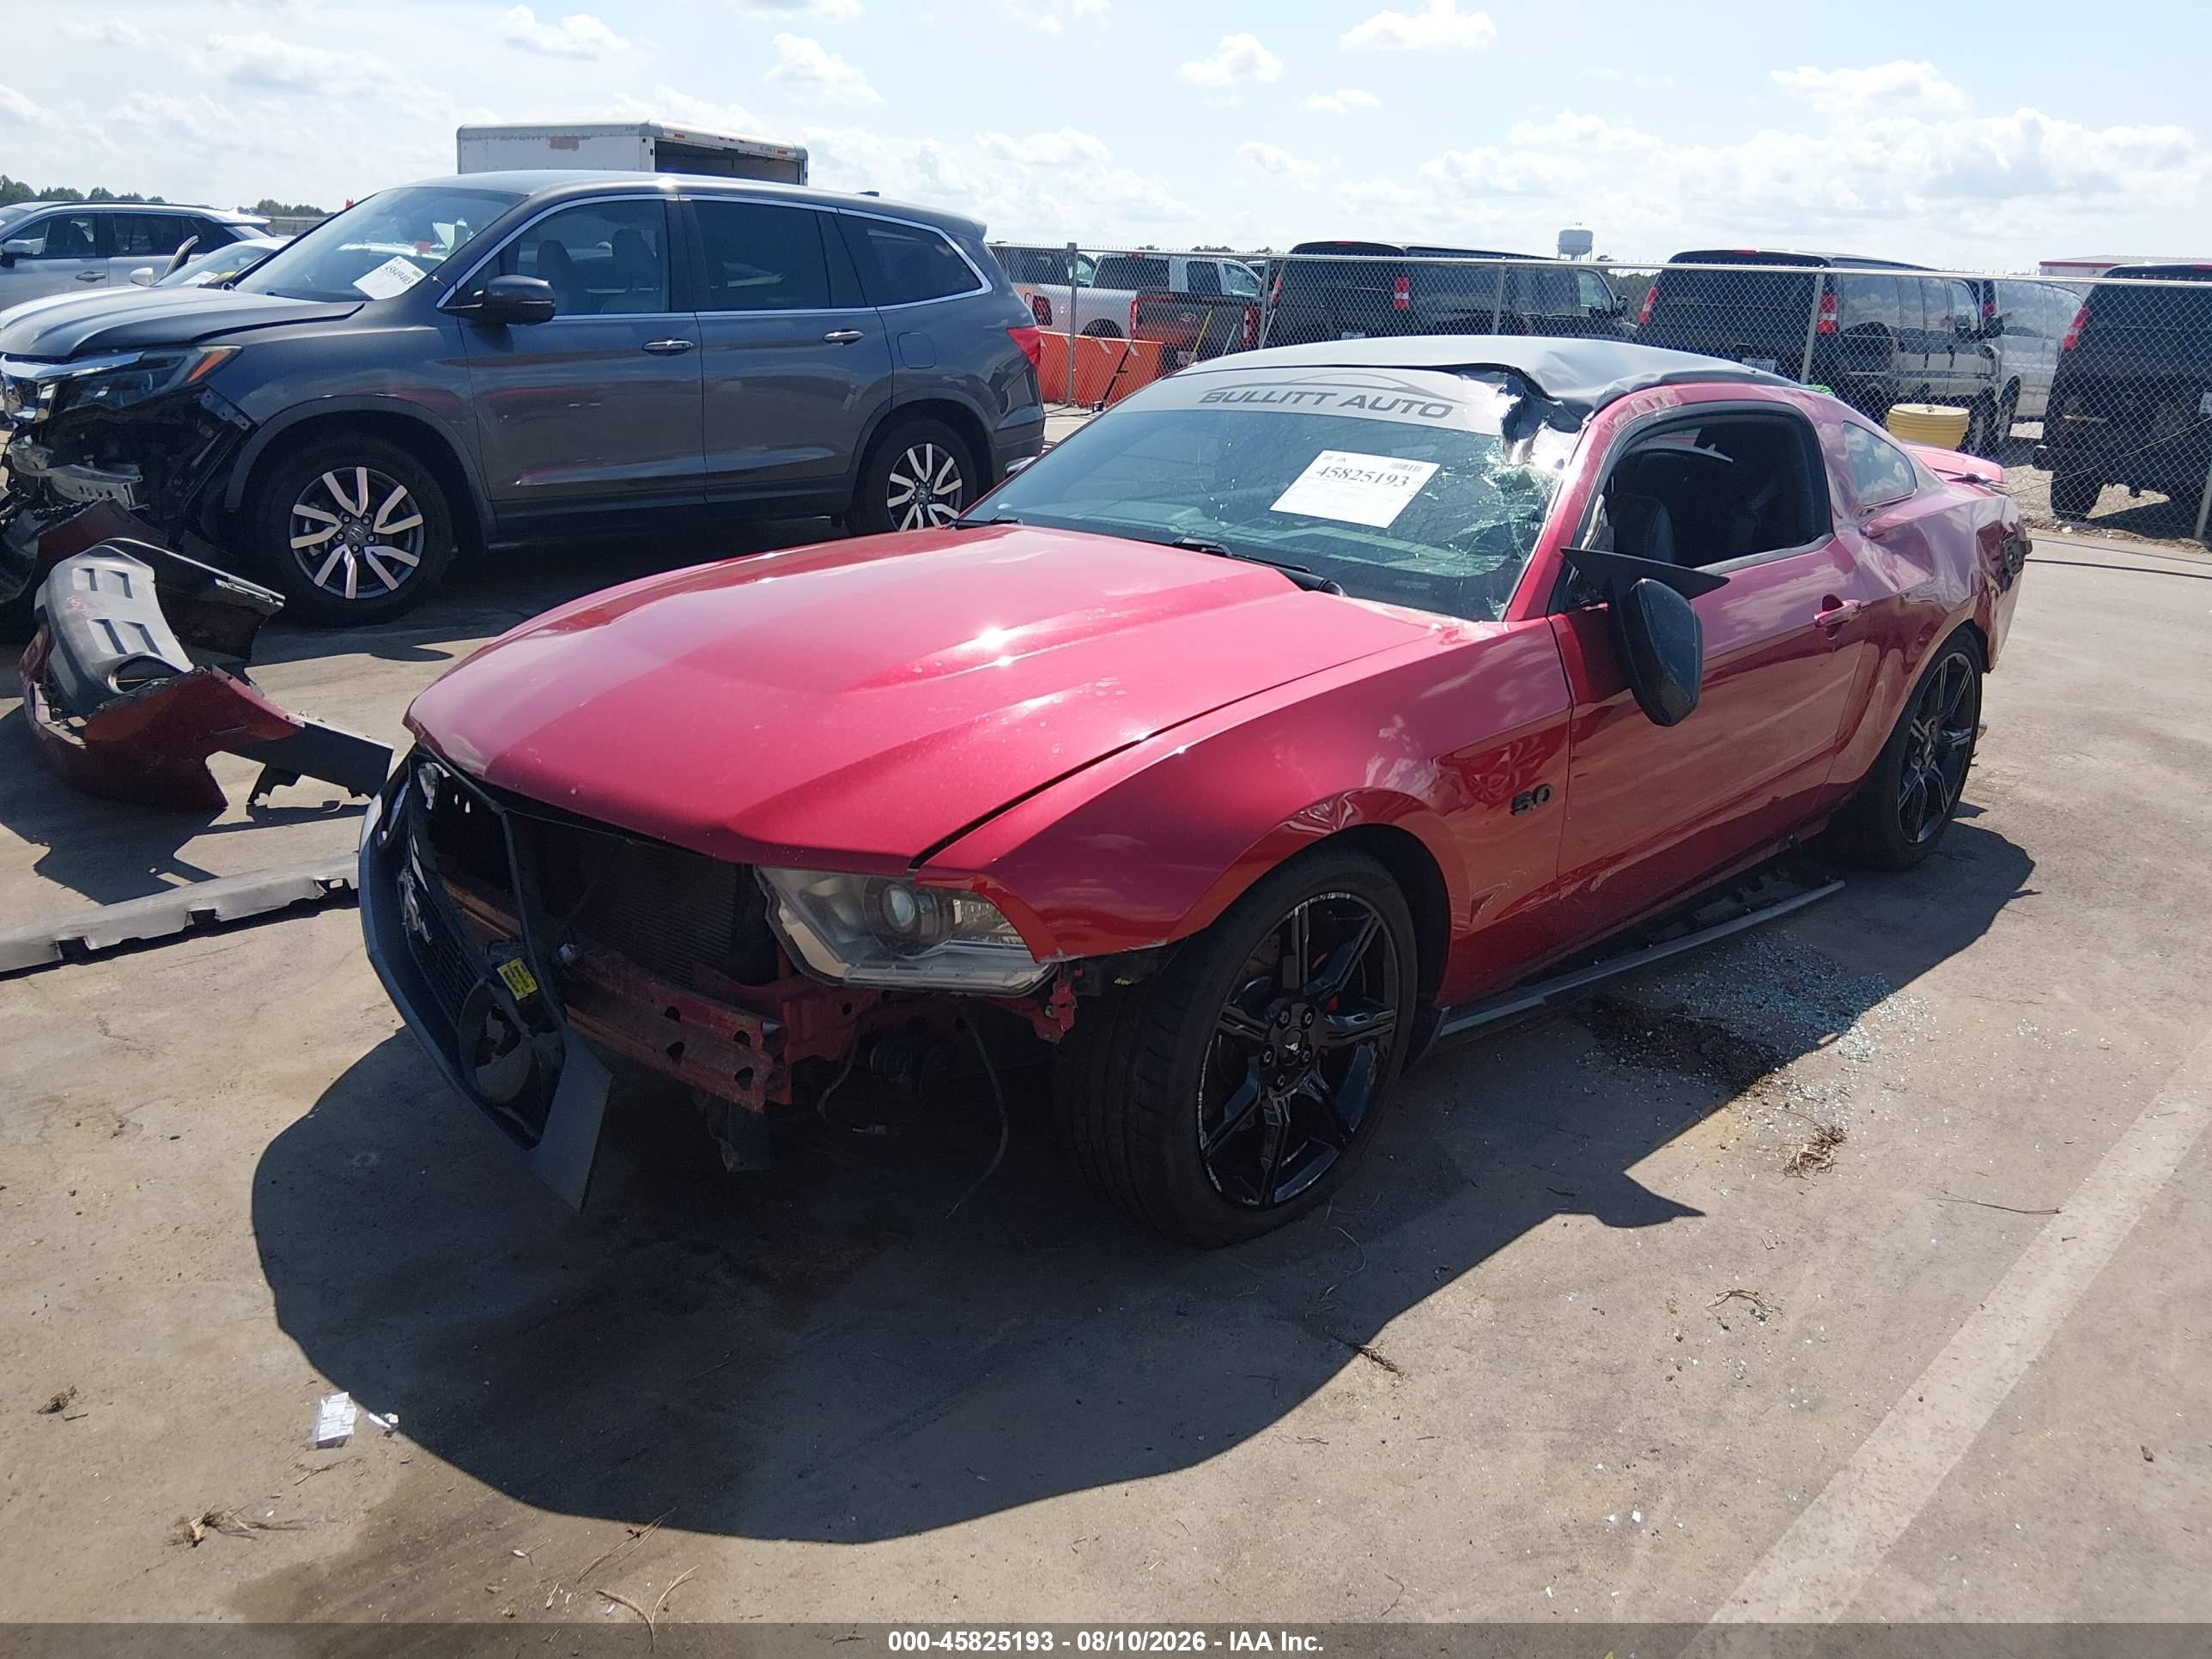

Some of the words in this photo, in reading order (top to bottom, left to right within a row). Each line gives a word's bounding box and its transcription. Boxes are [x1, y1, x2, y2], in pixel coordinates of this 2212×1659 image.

[1198, 391, 1339, 406] BULLITT
[1337, 394, 1455, 419] AUTO
[1316, 465, 1411, 488] 45825193
